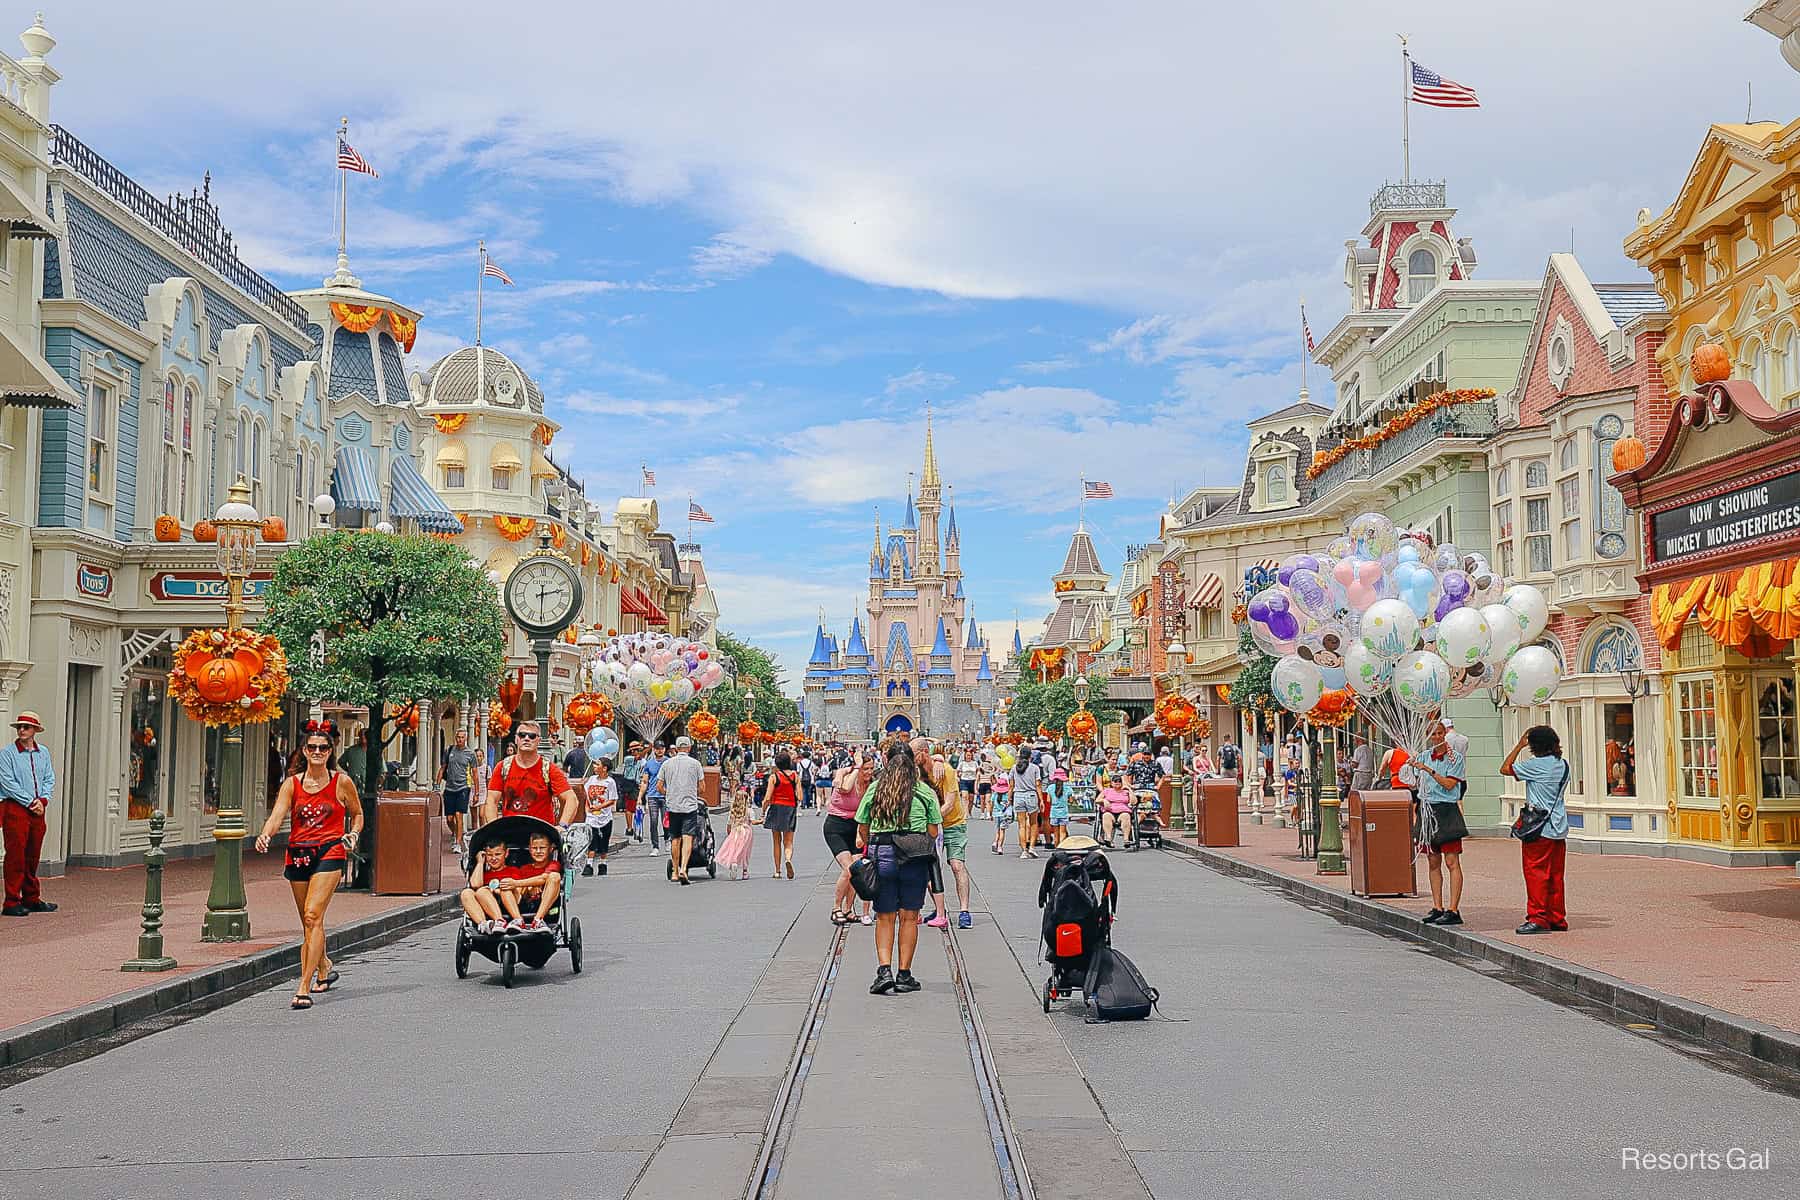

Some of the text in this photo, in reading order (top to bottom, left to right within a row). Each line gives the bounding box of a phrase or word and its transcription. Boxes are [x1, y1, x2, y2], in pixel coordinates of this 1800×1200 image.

[1689, 486, 1769, 525] NOW SHOWING
[1666, 504, 1800, 556] MICKEY MOUSETERPIECES
[85, 575, 104, 590] TOYS
[196, 581, 256, 595] DOLS
